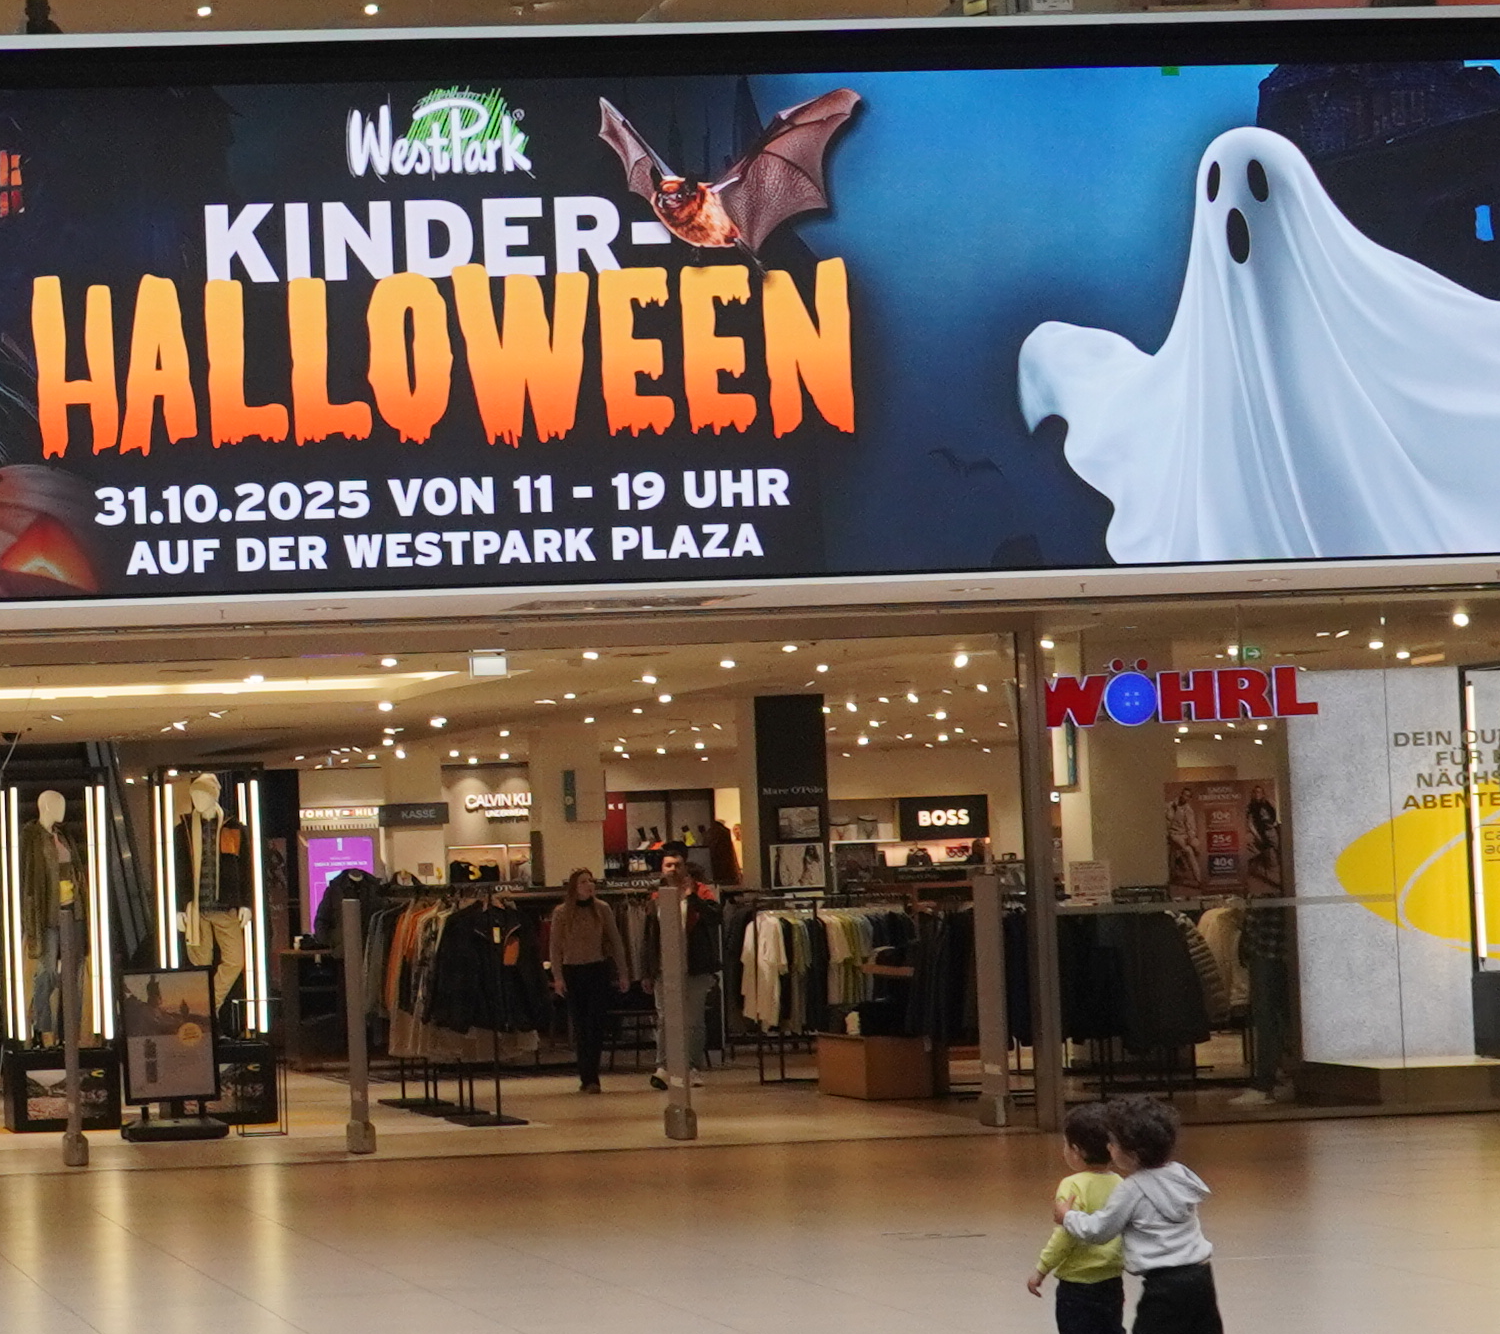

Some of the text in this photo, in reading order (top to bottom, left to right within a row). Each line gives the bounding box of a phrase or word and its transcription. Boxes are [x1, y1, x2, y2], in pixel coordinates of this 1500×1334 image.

[348, 97, 532, 177] WestPark
[204, 195, 672, 284] KINDER-
[31, 257, 856, 460] HALLOWEEN
[94, 468, 791, 527] 31.10.2025 VON 11 - 19 UHR
[126, 523, 765, 576] AUF DER WESTPARK PLAZA
[1046, 657, 1319, 729] WÖHRL
[1393, 730, 1452, 747] DEIN
[1435, 746, 1484, 766] FÜR
[762, 787, 788, 795] Marc
[464, 793, 512, 810] CALVIN
[299, 808, 341, 819] TOMMY
[401, 809, 436, 819] KASSE
[917, 808, 970, 827] BOSS
